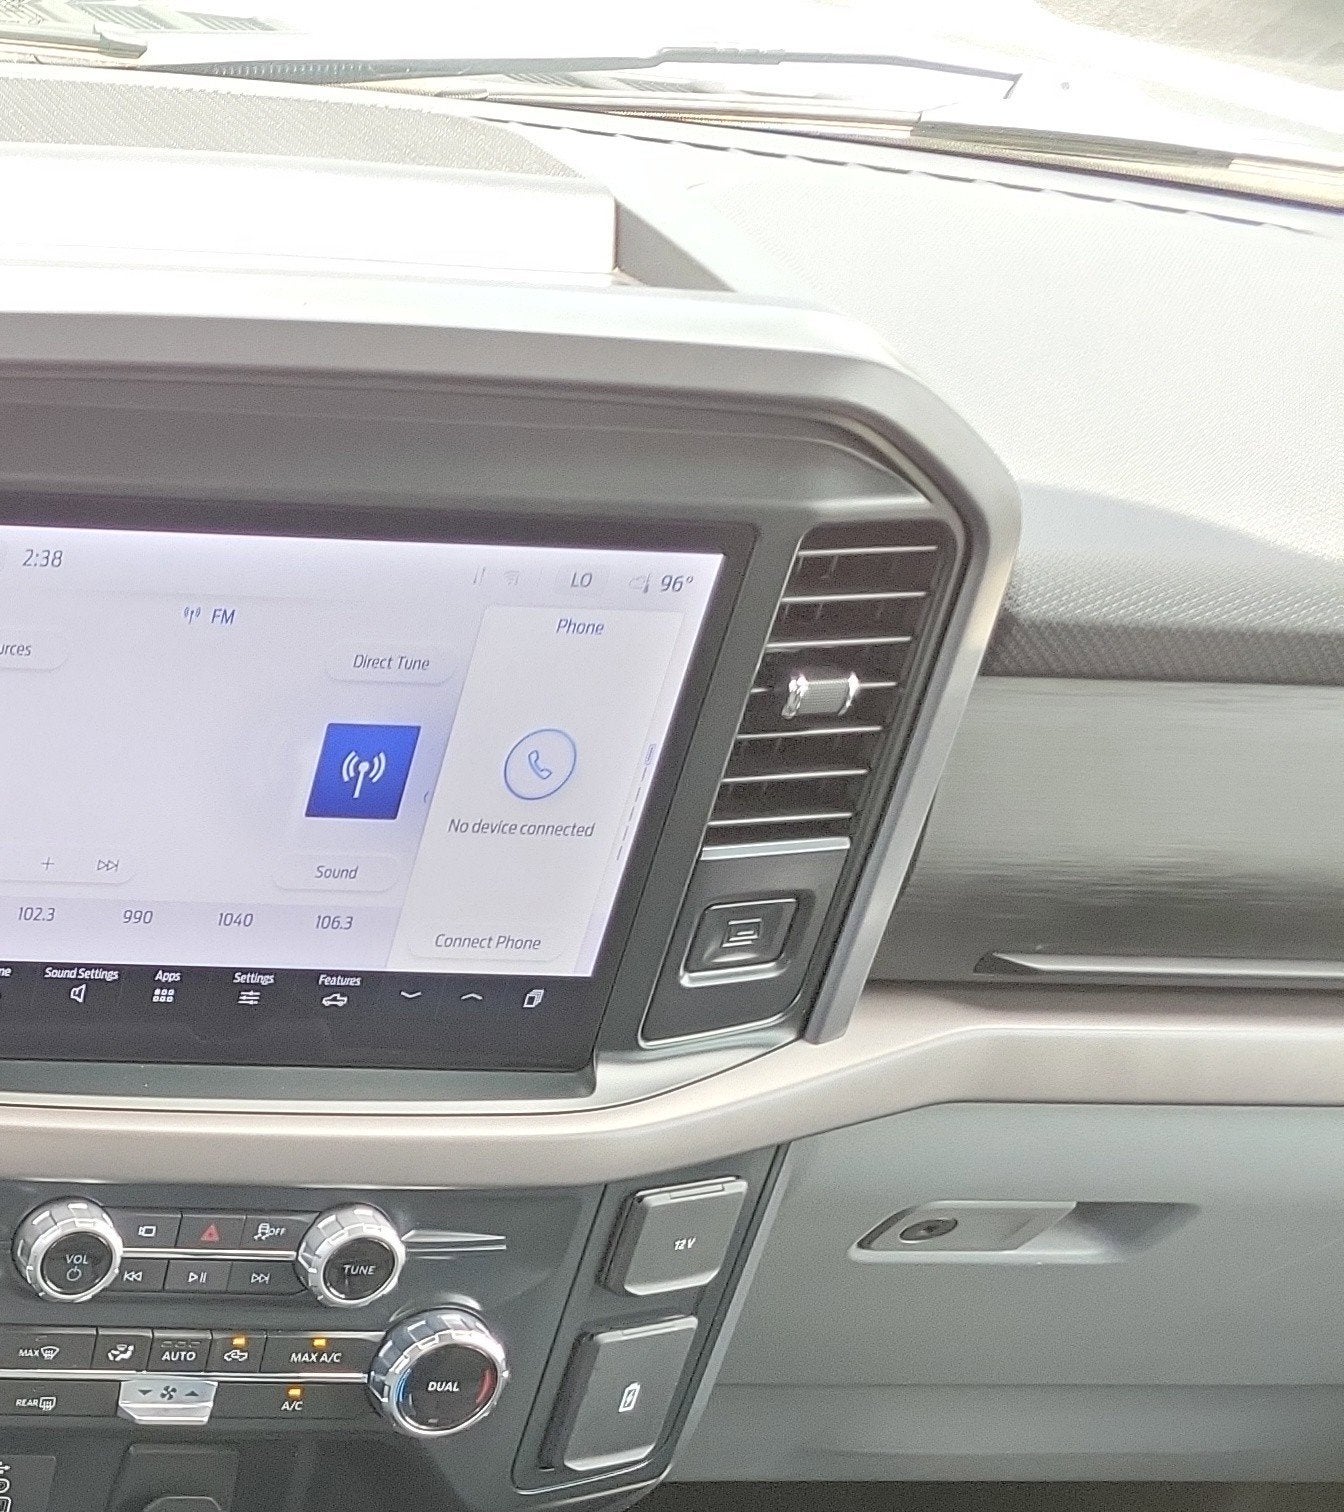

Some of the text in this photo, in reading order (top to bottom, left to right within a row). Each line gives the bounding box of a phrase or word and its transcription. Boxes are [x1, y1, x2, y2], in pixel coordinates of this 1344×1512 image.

[22, 549, 63, 568] 2:38
[570, 572, 592, 589] LO
[210, 608, 235, 625] FM
[556, 618, 604, 636] Phone
[353, 654, 430, 672] Direct Tune
[447, 819, 594, 838] No device connected
[314, 864, 358, 881] Sound
[17, 905, 55, 923] 102.3
[123, 909, 154, 925] 990
[217, 911, 254, 928] 1040
[314, 914, 353, 931] 106.3
[434, 933, 541, 951] Connect Phone
[45, 967, 119, 982] Sound Settings
[155, 970, 180, 984] Apps
[233, 972, 275, 986] Settings
[318, 974, 361, 987] Features
[269, 1227, 286, 1236] OFF
[66, 1254, 88, 1265] VOL
[343, 1265, 375, 1276] TUNE
[19, 1347, 40, 1358] MAX
[161, 1350, 196, 1362] AUTO
[290, 1352, 342, 1363] MAX A/C
[427, 1380, 459, 1392] DUAL
[16, 1397, 39, 1408] REAR
[281, 1400, 303, 1411] A/C
